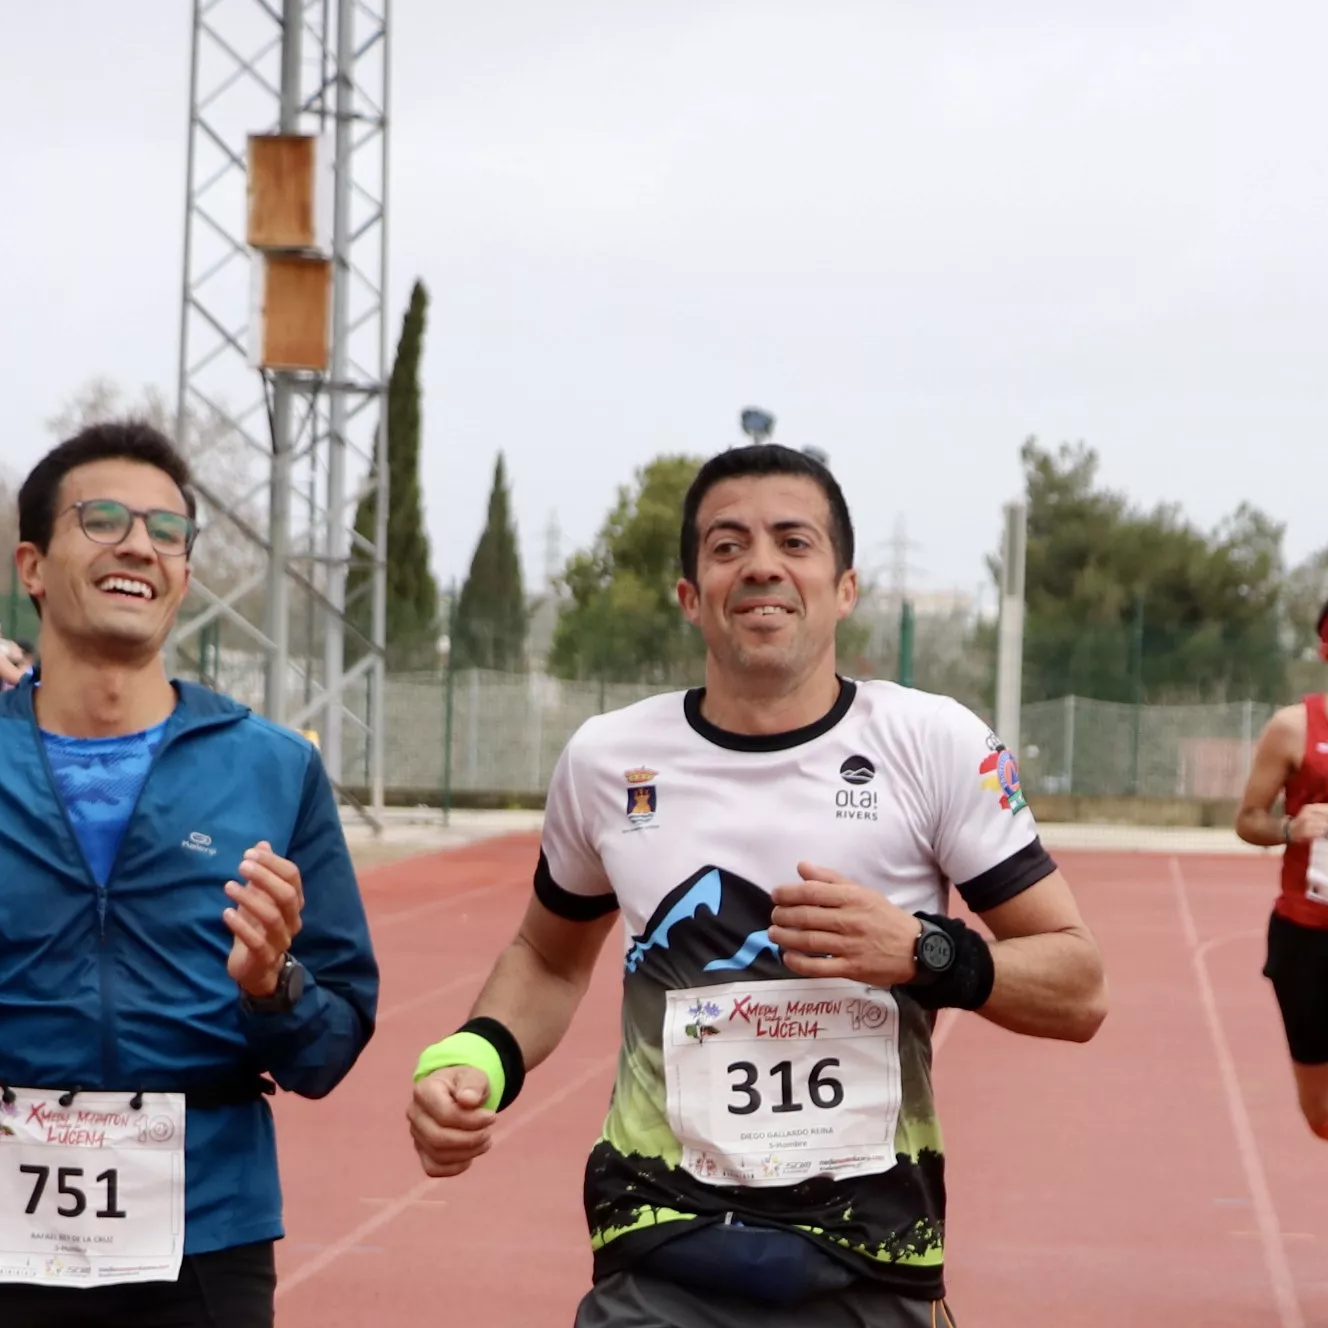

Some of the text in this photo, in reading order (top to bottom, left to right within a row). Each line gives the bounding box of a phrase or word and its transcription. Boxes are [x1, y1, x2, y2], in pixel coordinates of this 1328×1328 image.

[835, 810, 878, 821] RIVERS
[756, 1019, 828, 1040] LUCENA
[726, 1057, 845, 1116] 316
[47, 1126, 115, 1148] LUCENA
[740, 1132, 766, 1141] DIEGO
[767, 1128, 809, 1139] GALLARDO
[19, 1164, 127, 1219] 751
